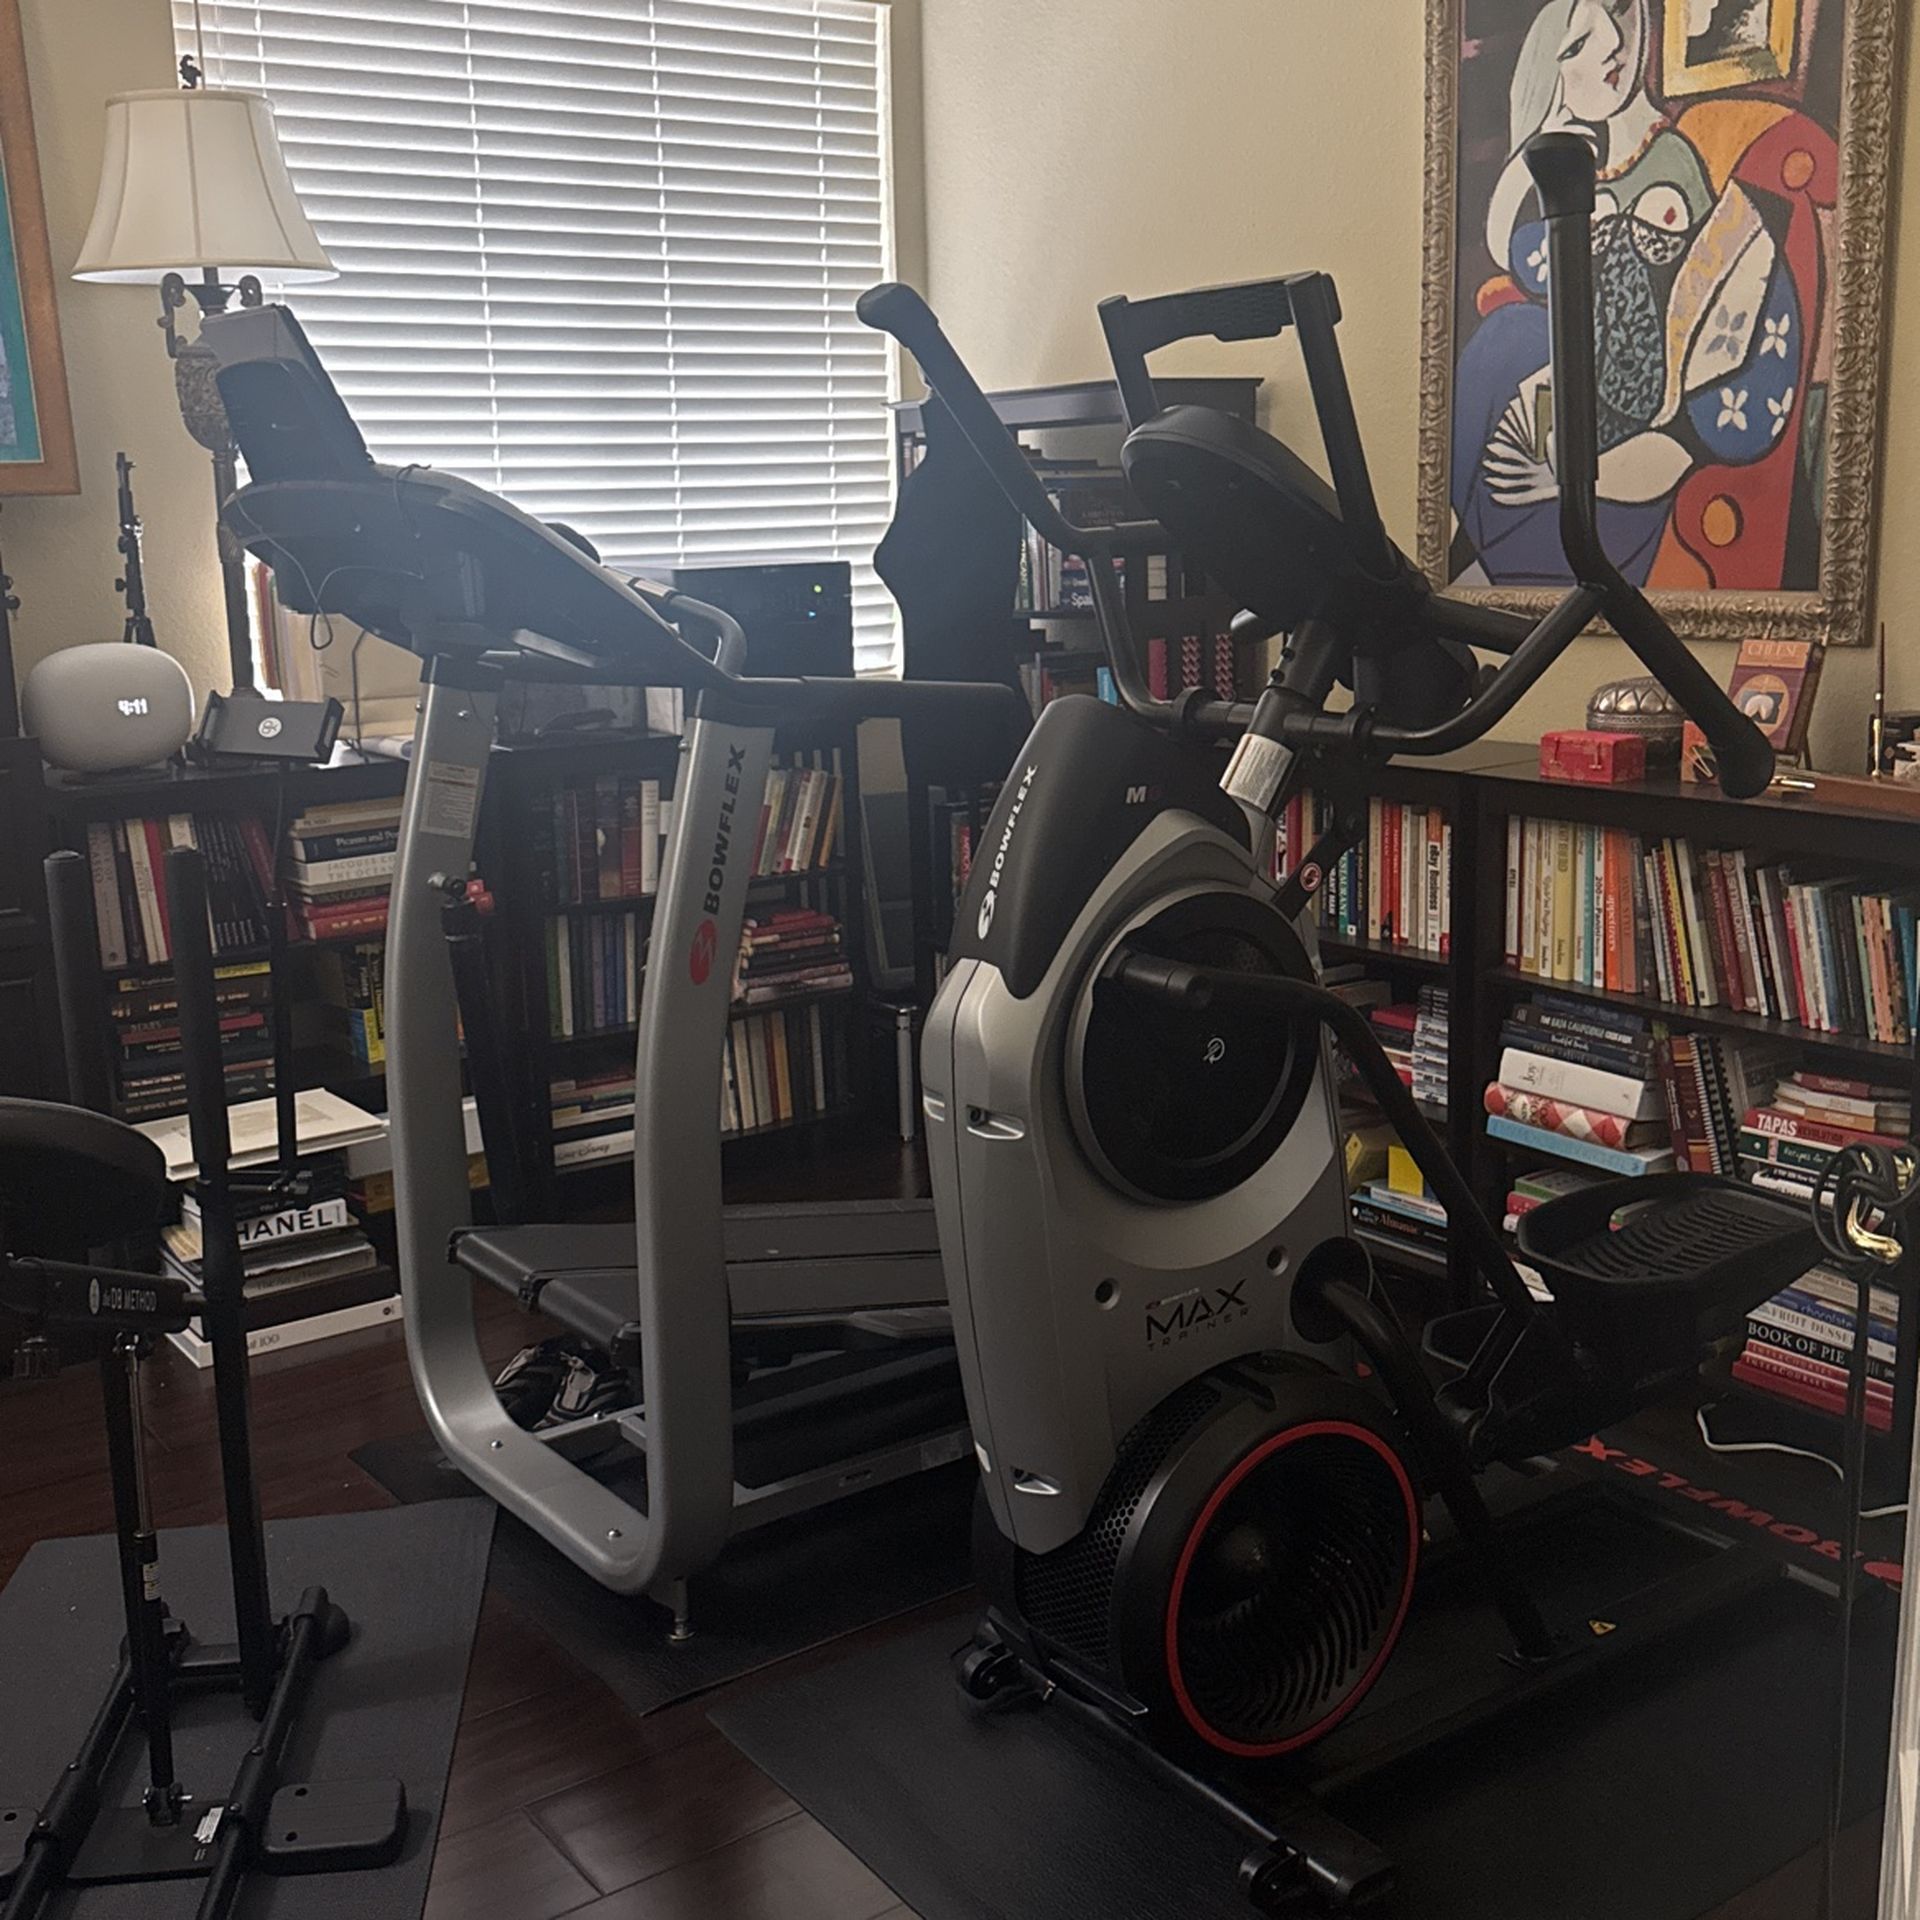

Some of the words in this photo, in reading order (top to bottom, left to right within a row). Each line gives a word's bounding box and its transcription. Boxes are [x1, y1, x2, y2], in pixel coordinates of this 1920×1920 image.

[704, 744, 746, 915] BOWFLEX
[989, 765, 1038, 888] BOWFLEX
[1429, 870, 1440, 911] Business
[1605, 894, 1617, 952] appetizers
[1757, 1113, 1798, 1136] TAPAS
[238, 1209, 333, 1241] HANEL
[124, 1289, 158, 1312] METHOD
[1147, 1278, 1247, 1341] MAX
[1148, 1307, 1249, 1351] TRAINER
[1749, 1322, 1793, 1348] BOOK
[1795, 1335, 1815, 1355] OF
[1820, 1345, 1846, 1366] PIE
[1810, 1320, 1854, 1344] DESSE
[1572, 1434, 1842, 1561] BOWFLEX
